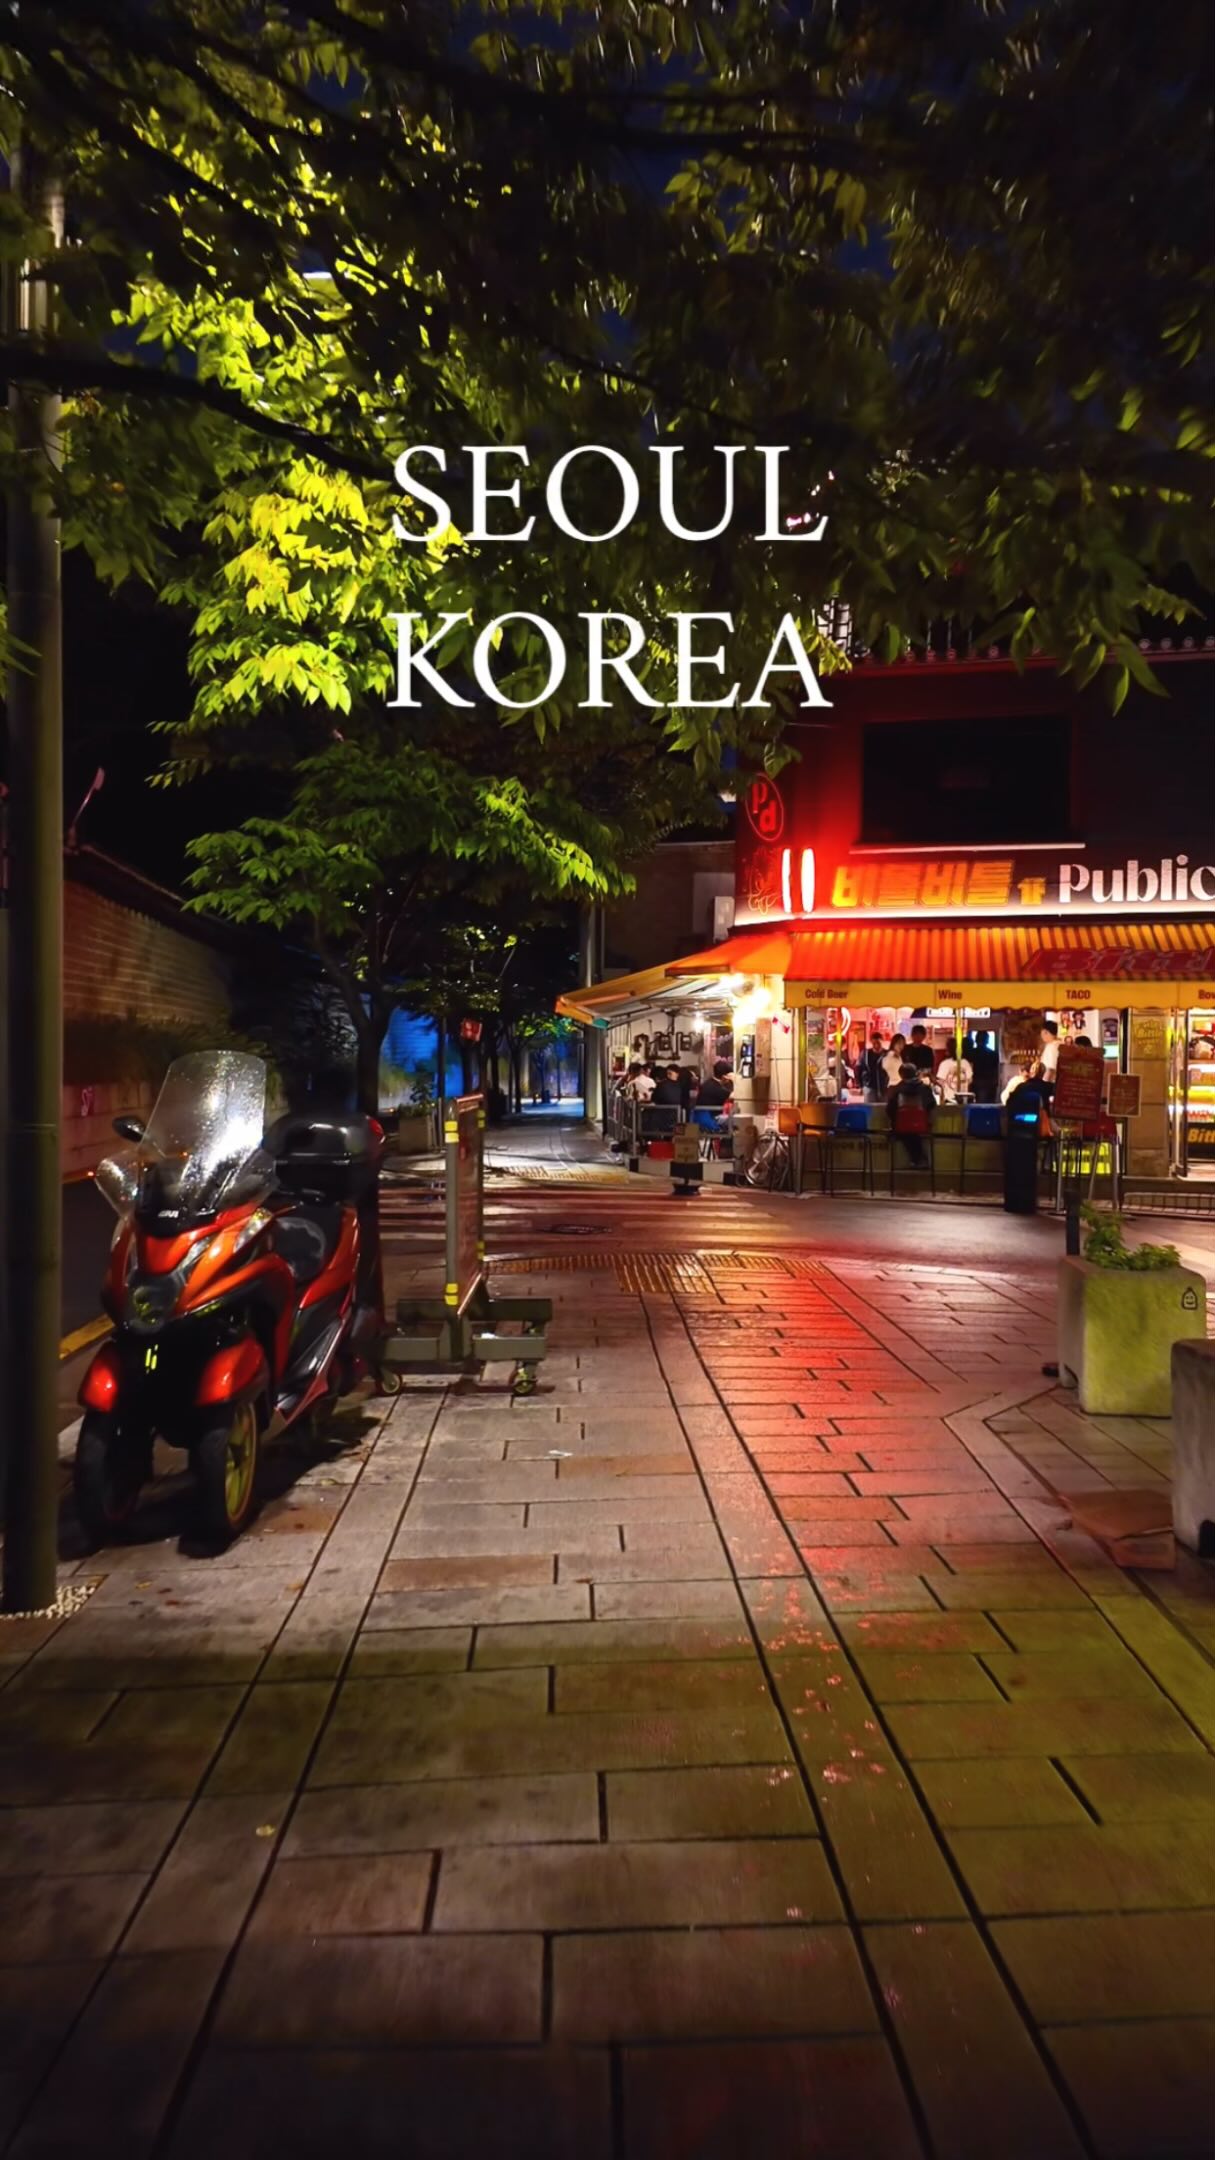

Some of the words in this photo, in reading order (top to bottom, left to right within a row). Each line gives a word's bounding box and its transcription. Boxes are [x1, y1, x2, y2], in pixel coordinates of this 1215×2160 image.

[1059, 854, 1215, 903] Public
[805, 988, 824, 1000] Cold
[827, 988, 848, 1000] Beer
[938, 989, 963, 1000] Wine
[1066, 989, 1091, 1000] TACO
